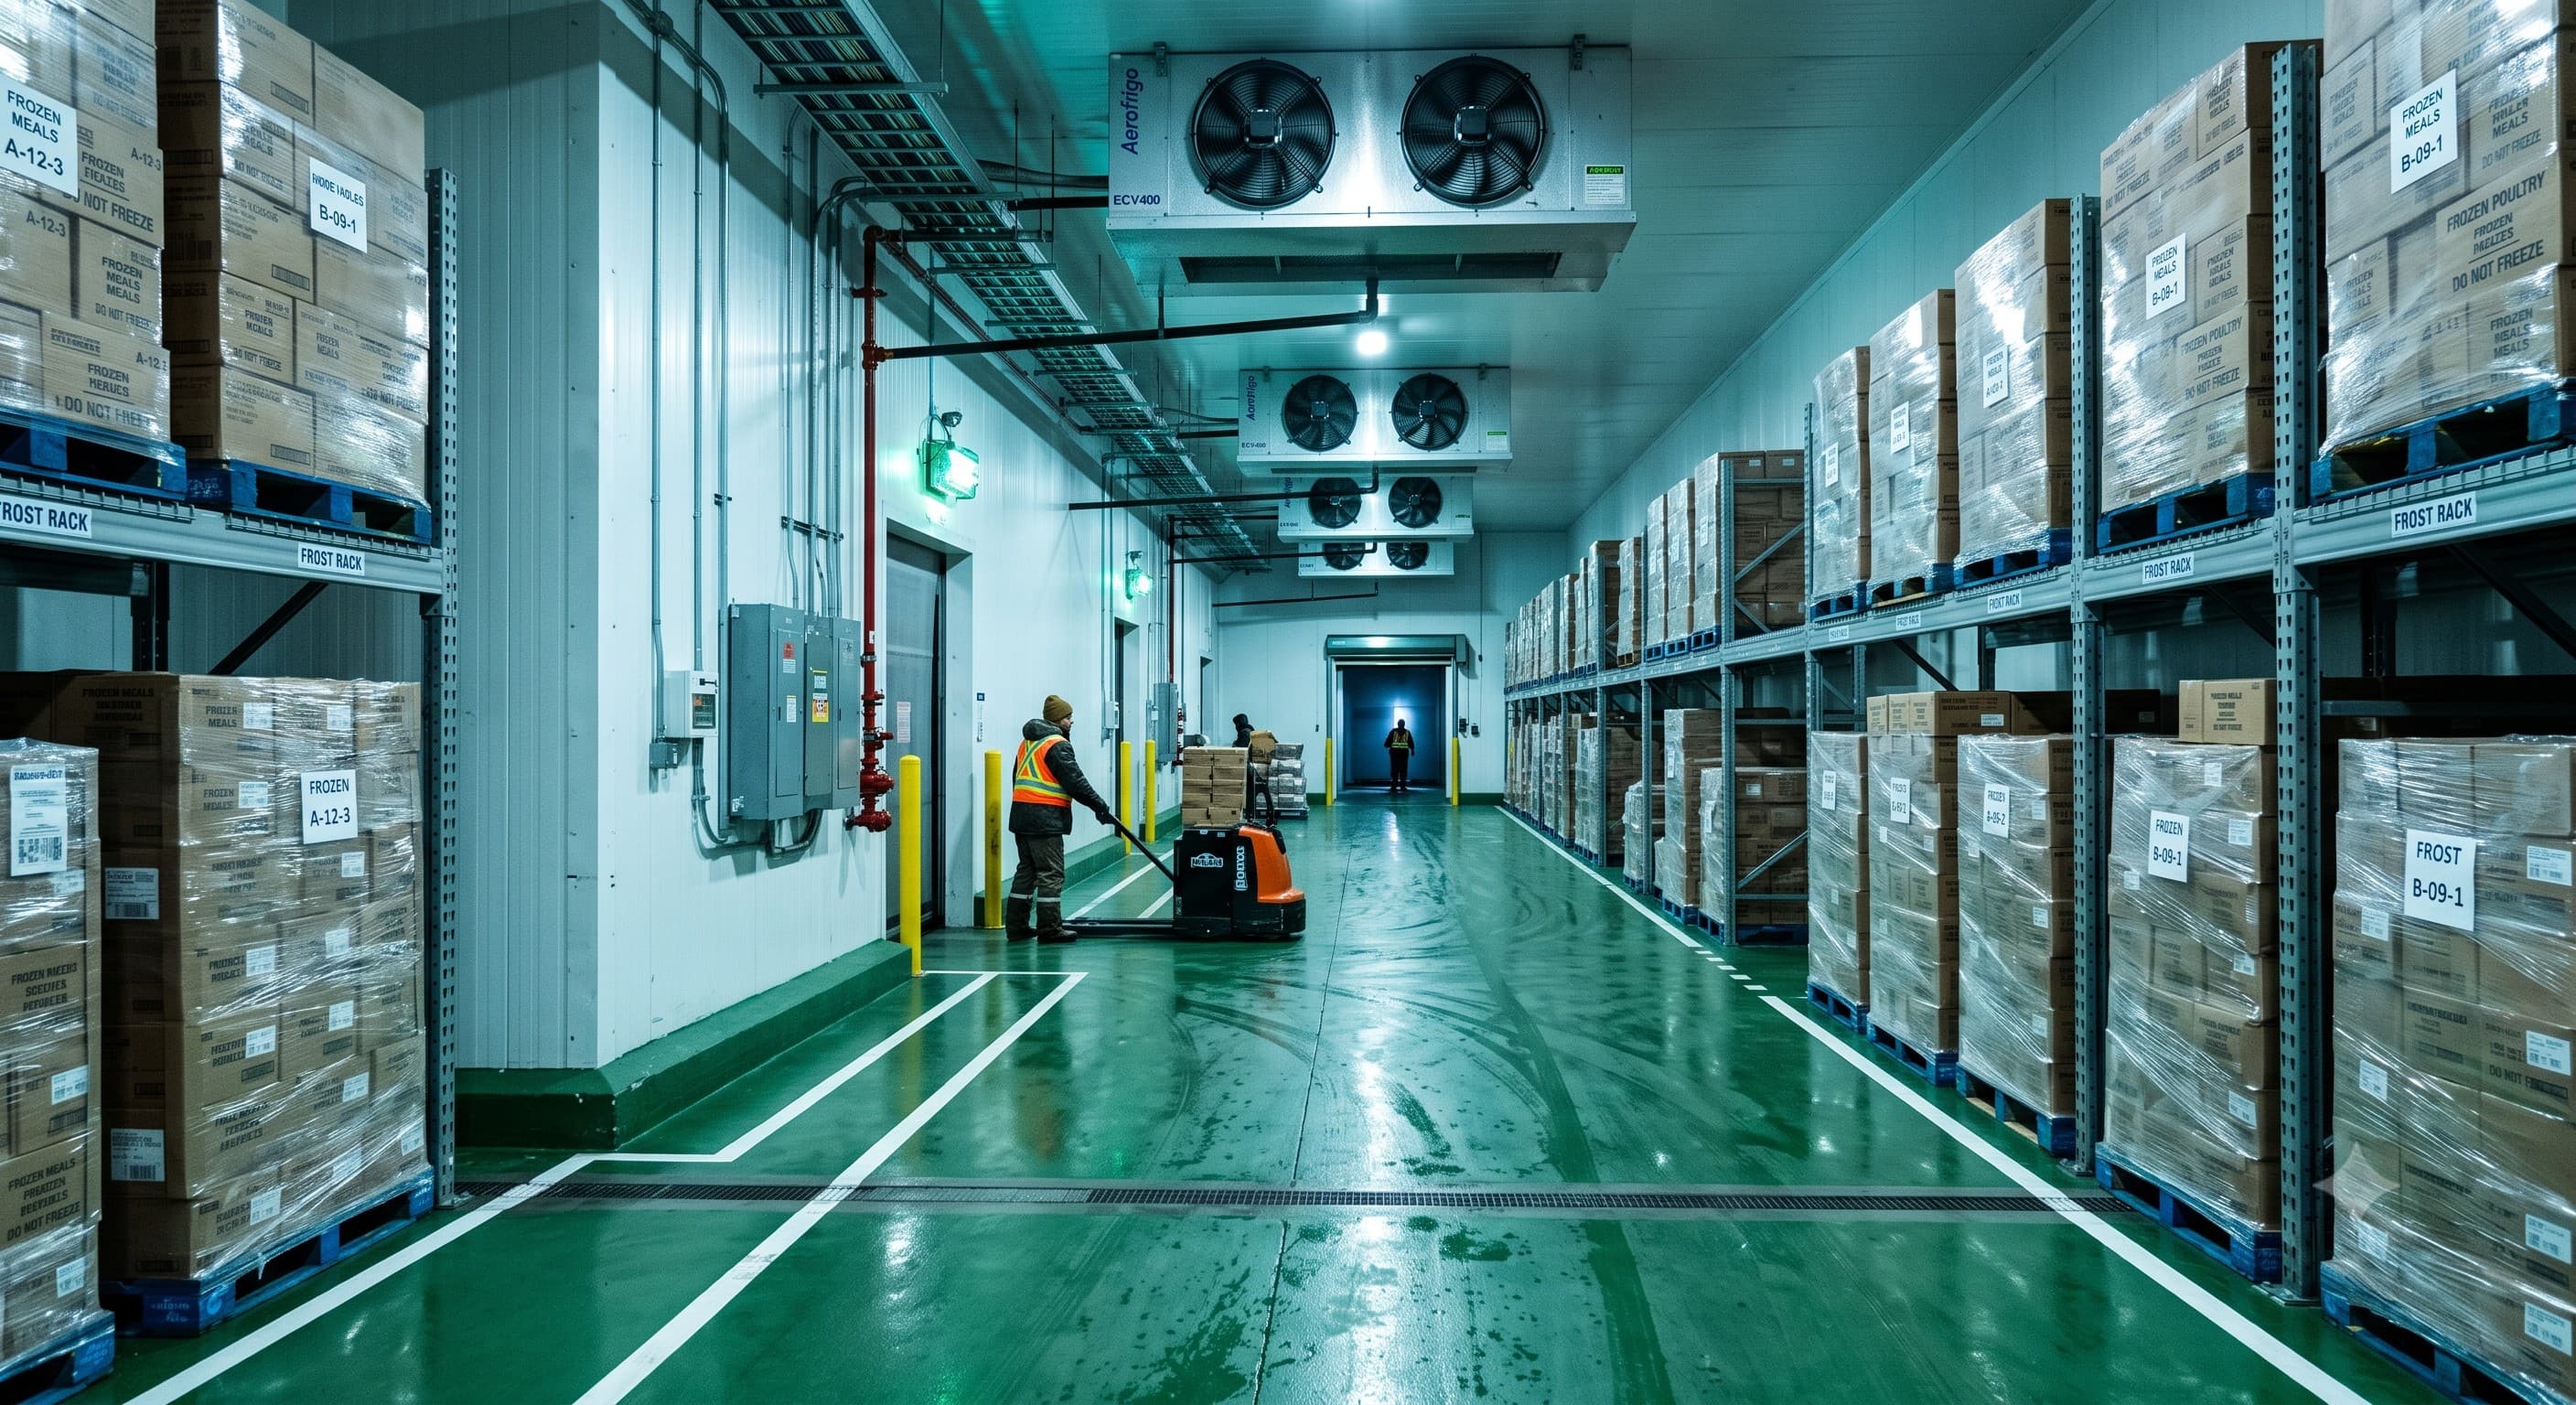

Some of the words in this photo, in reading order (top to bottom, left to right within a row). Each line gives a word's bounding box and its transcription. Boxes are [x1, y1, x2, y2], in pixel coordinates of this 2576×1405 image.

[7, 90, 61, 126] FROZEN
[1121, 68, 1143, 156] Aerofrigo
[2402, 88, 2443, 123] FROZEN
[12, 112, 59, 143] MEALS
[2405, 109, 2441, 140] MEALS
[5, 138, 64, 176] A-12-3
[131, 147, 162, 171] A-12-3
[2401, 134, 2442, 173] B-09-1
[84, 191, 108, 213] NOT
[112, 202, 154, 232] FREEZE
[1113, 194, 1161, 206] ECV400
[2447, 198, 2489, 233] FROZEN
[2492, 170, 2545, 211] POULTRY
[26, 210, 66, 237] A-12-3
[319, 203, 357, 233] B-09-1
[2474, 212, 2513, 240] FROZEN
[102, 256, 143, 279] FROZEN
[2453, 273, 2467, 293] DO
[2471, 260, 2495, 284] NOT
[2497, 240, 2544, 273] FREEZE
[106, 271, 140, 291] MEALS
[106, 284, 140, 304] MEALS
[88, 363, 130, 383] FROZEN
[64, 396, 82, 413] DO
[0, 501, 43, 525] ROST
[48, 509, 88, 531] RACK
[2395, 506, 2433, 531] FROST
[2437, 498, 2473, 522] RACK
[301, 548, 334, 566] FROST
[336, 552, 362, 571] RACK
[2144, 561, 2169, 579] FROST
[208, 718, 238, 728] MEALS
[309, 778, 349, 795] FROZEN
[310, 807, 350, 827] A-12-3
[2155, 819, 2184, 836] FROZEN
[2417, 842, 2462, 865] FROST
[2413, 878, 2463, 907] B-09-1
